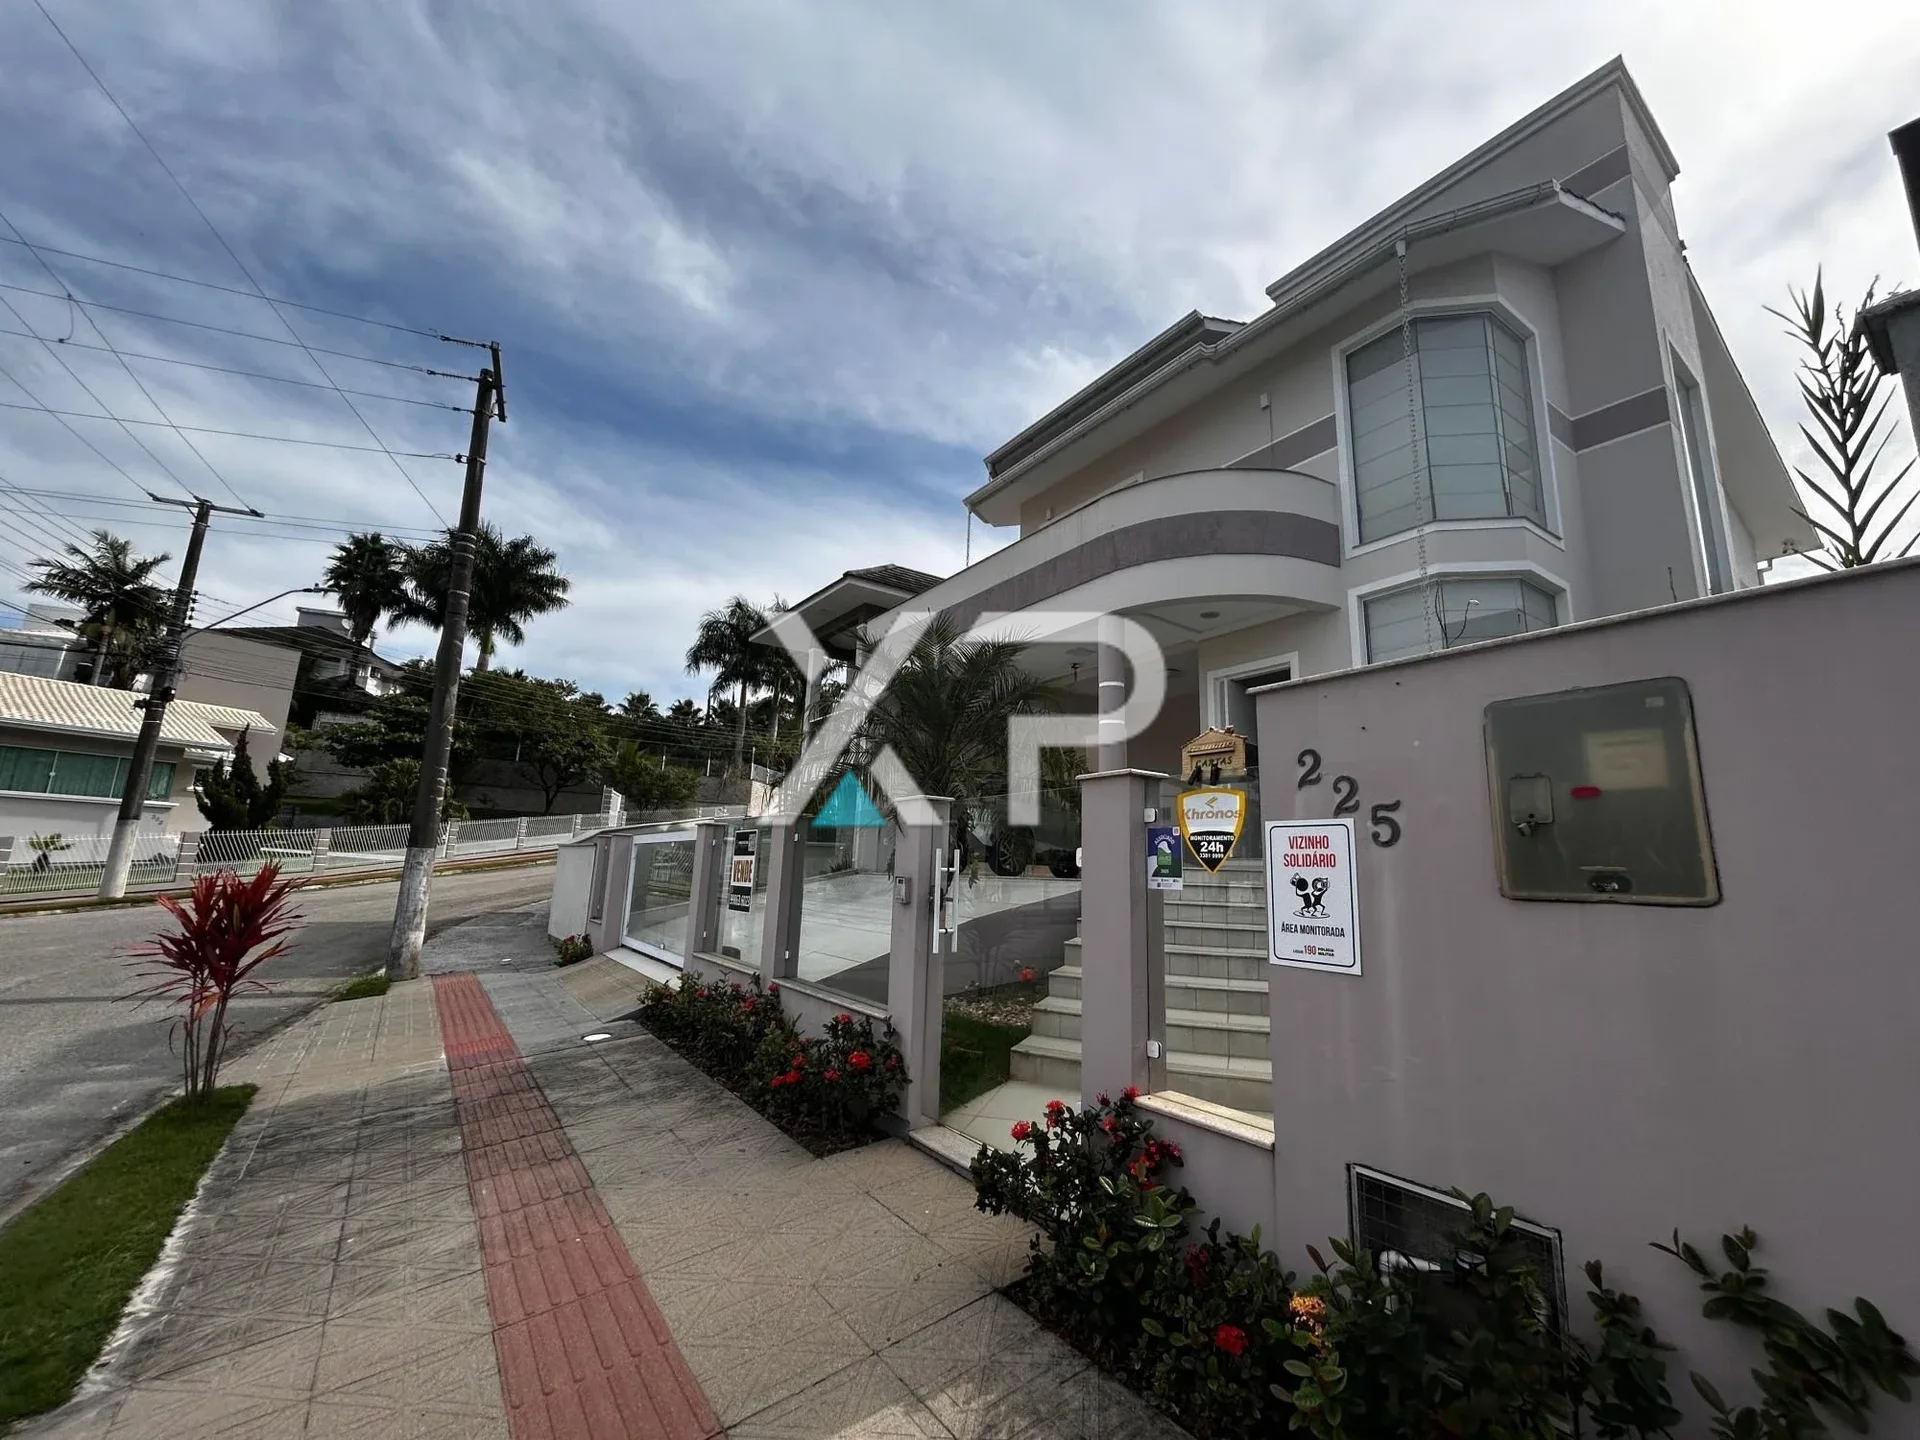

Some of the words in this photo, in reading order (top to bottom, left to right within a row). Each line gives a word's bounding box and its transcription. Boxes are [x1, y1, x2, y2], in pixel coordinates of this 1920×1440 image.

[1297, 748, 1402, 848] 225
[1200, 841, 1224, 853] 24h
[1288, 835, 1329, 850] VIZINHO
[1283, 851, 1337, 868] SOLIDÁRIO
[733, 859, 753, 883] VENDE
[1281, 921, 1299, 934] ÁREA
[1299, 924, 1345, 938] MONITORADA
[1304, 945, 1316, 955] 190
